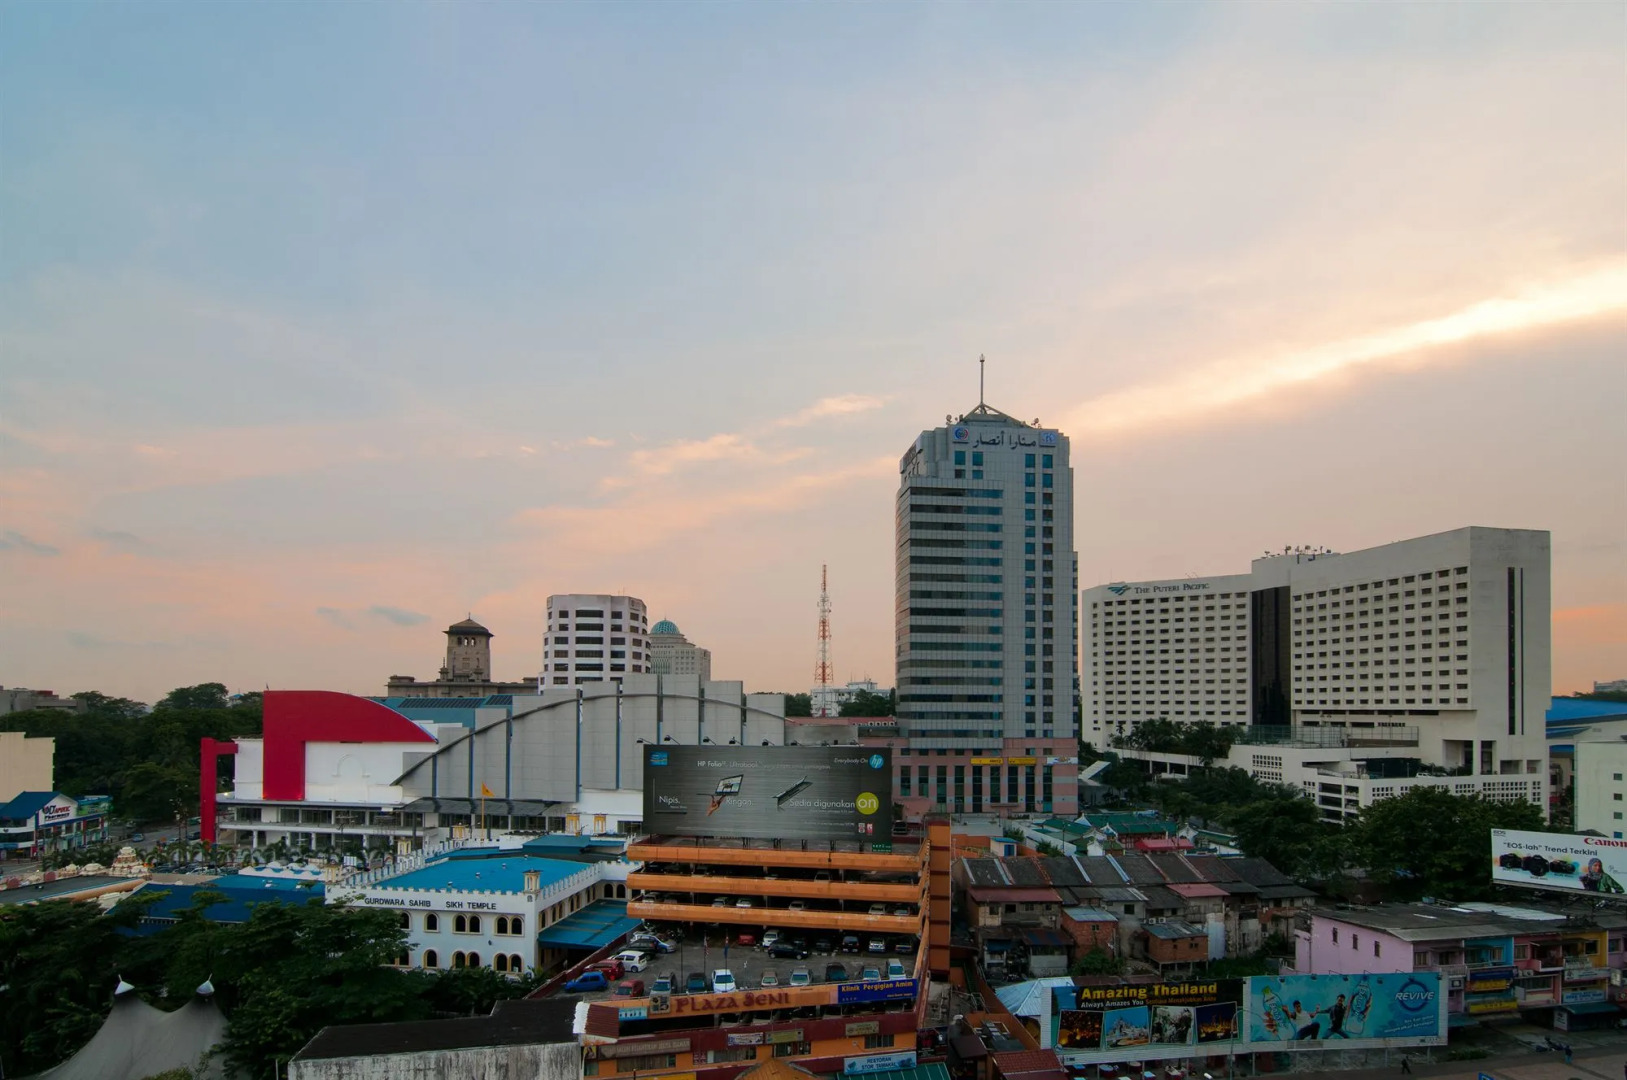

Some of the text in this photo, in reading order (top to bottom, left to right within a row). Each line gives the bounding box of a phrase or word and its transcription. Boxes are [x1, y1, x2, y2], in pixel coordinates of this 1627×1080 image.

[1153, 585, 1180, 593] PUTERI
[814, 800, 855, 809] digunakan
[858, 799, 876, 808] on
[1584, 837, 1627, 847] Canon
[1570, 848, 1597, 856] Terkini
[364, 897, 405, 906] GURDWARA
[467, 902, 496, 910] TEMPLE
[1082, 983, 1218, 1000] Amazing Thailand
[1395, 991, 1435, 1001] REVIVE
[676, 996, 738, 1012] PLAZA
